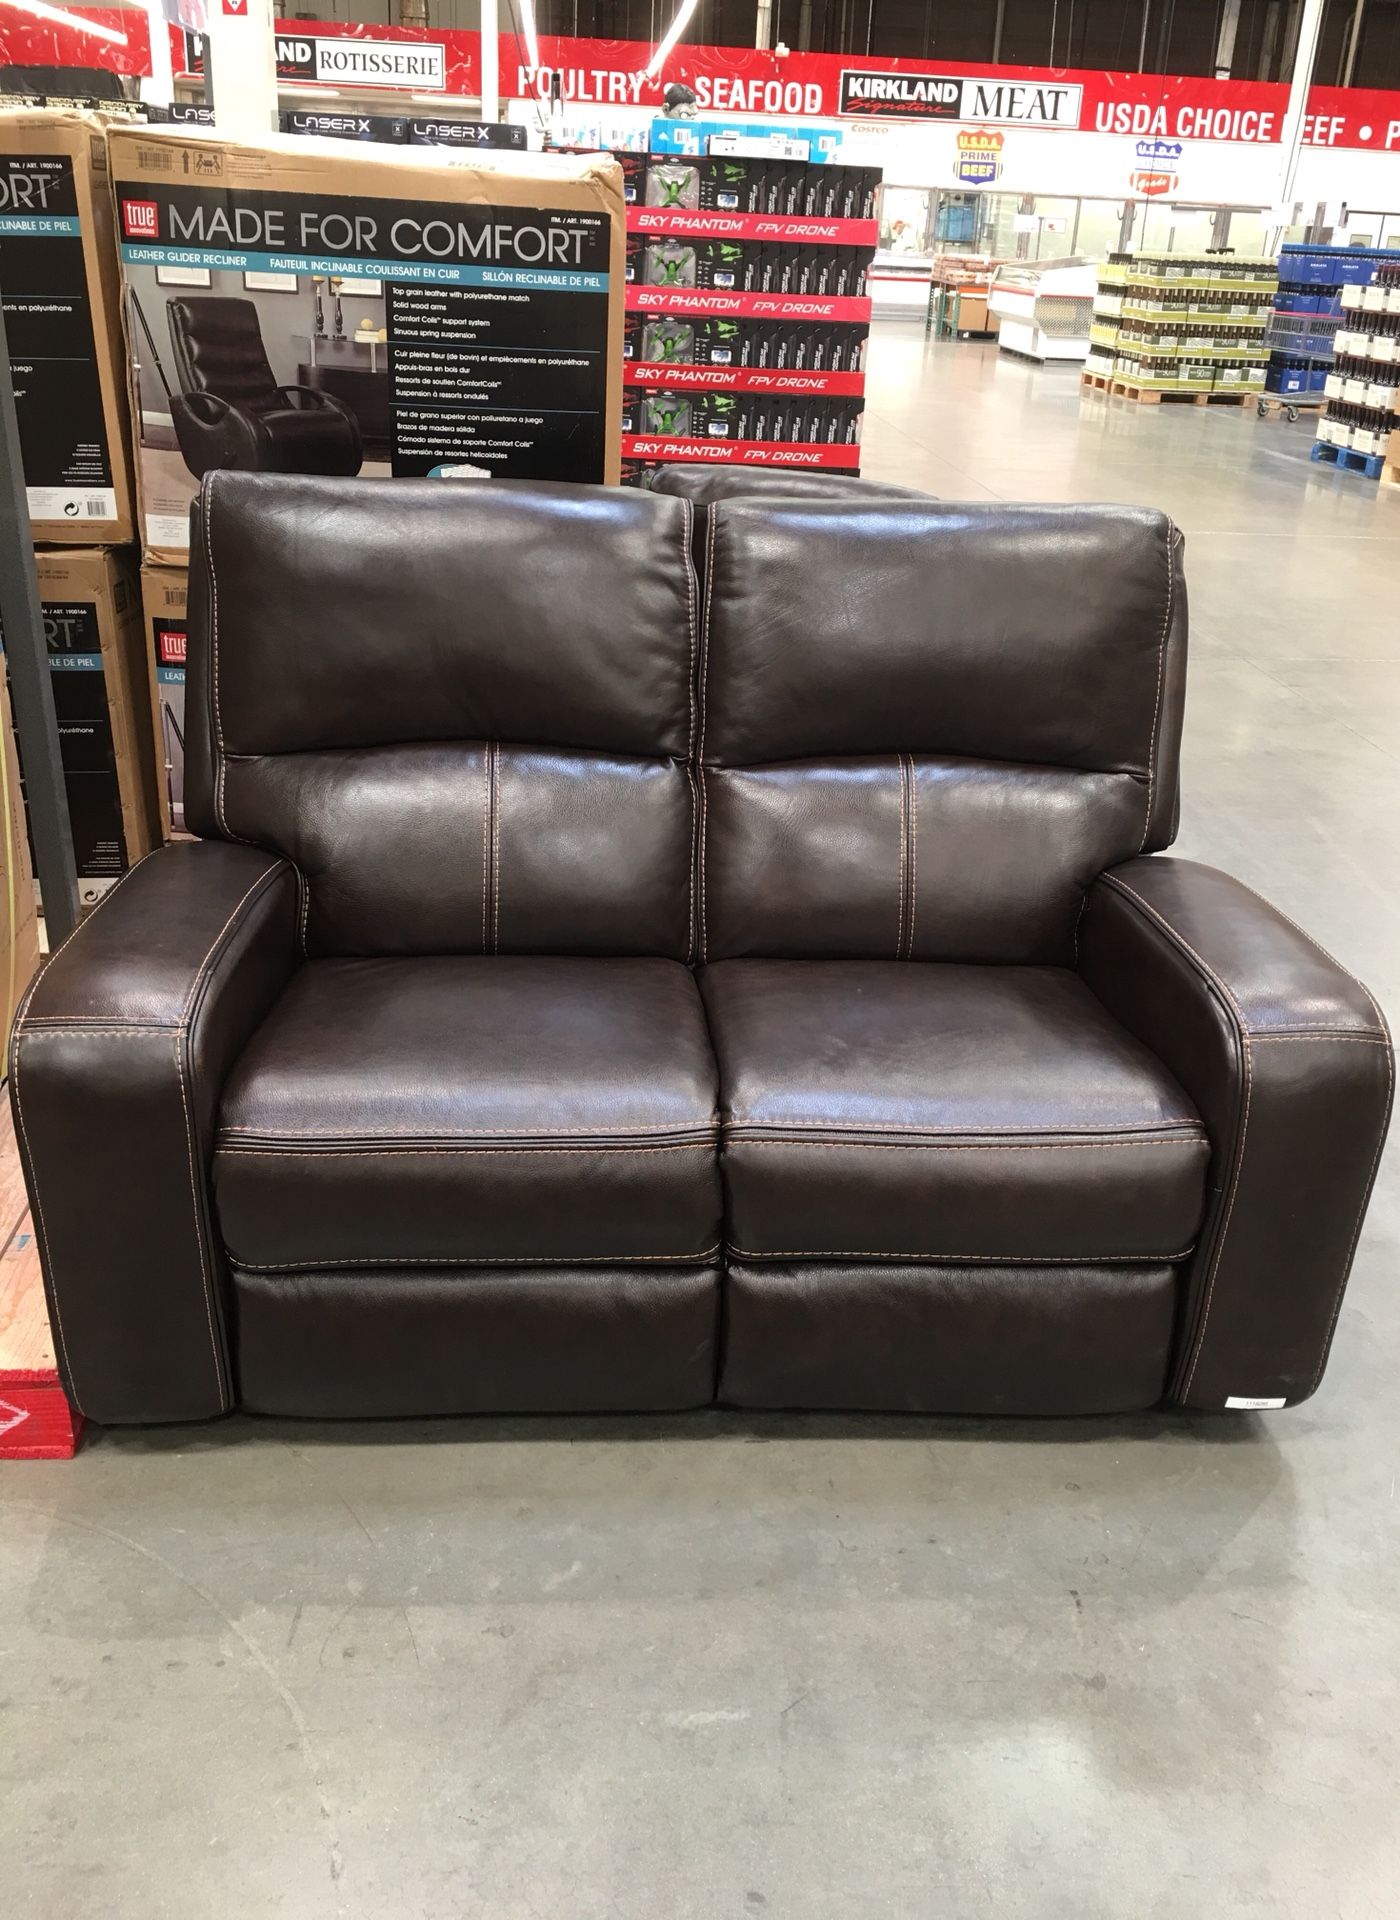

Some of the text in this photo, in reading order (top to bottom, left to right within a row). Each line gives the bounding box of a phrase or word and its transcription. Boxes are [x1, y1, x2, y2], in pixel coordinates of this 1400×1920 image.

[319, 50, 439, 76] ROTISSERIE
[517, 65, 823, 114] POULTRY SEAFOOD
[848, 77, 959, 103] KIRKLAND
[846, 96, 955, 115] Signature
[972, 84, 1069, 121] MEAT
[293, 115, 356, 131] LASER
[358, 119, 370, 133] X
[413, 123, 476, 138] LASER
[477, 126, 490, 140] X
[1095, 101, 1345, 146] USDA CHOICE EEF
[960, 151, 997, 161] PRIME
[961, 164, 995, 177] BEEF
[127, 203, 155, 226] true
[0, 221, 72, 231] LINABLE DE PIEL
[168, 204, 286, 246] MADE
[300, 212, 378, 252] FOR
[390, 218, 589, 264] COMFORT
[638, 214, 840, 237] SKY PHANTOM FPV DRONE
[129, 249, 247, 266] LEATHER GLIDER RECLINER
[270, 258, 460, 279] FAUTEUIL INCLINABLE COULISSANT EN CUIR
[482, 270, 601, 287] SILLÓN RECLINABLE DE PIEL
[392, 287, 530, 302] Top grain leather with polyurethane match
[392, 301, 447, 311] Solid wood arms
[637, 293, 835, 315] SKY PHANTOM FPV DRONE
[393, 314, 420, 323] Comfort
[442, 318, 467, 328] support
[468, 319, 490, 328] system
[393, 327, 476, 340] Sinuous spring suspension
[394, 350, 408, 358] Cuir
[409, 351, 430, 360] pleine
[431, 352, 446, 360] fleur
[480, 354, 488, 362] et
[548, 357, 590, 367] polyuréthane
[394, 363, 433, 373] Appuis-bras
[459, 366, 471, 374] dur
[395, 376, 421, 384] Ressorts
[421, 377, 431, 385] de
[432, 378, 456, 386] soutien
[634, 368, 829, 389] SKY PHANTOM FPV DRONE
[395, 389, 431, 399] Suspension
[439, 391, 463, 399] ressorts
[463, 392, 489, 400] ondulés
[396, 410, 408, 418] Piel
[409, 411, 419, 419] de
[419, 412, 440, 422] grano
[440, 413, 466, 423] superior
[481, 415, 518, 424] poliuretano
[524, 416, 544, 425] juego
[396, 423, 418, 431] Brazos
[428, 424, 455, 432] madera
[456, 425, 475, 433] sólida
[397, 435, 426, 444] Cómodo
[427, 436, 451, 444] sistema
[452, 437, 462, 445] de
[462, 438, 487, 448] soporte
[487, 439, 514, 447] Comfort
[397, 447, 433, 457] Suspensión
[444, 450, 469, 458] resortes
[469, 451, 508, 459] helicoidales
[633, 442, 824, 463] SKY PHANTOM FPV DRONE
[63, 658, 75, 667] DE
[77, 658, 95, 667] PIEL
